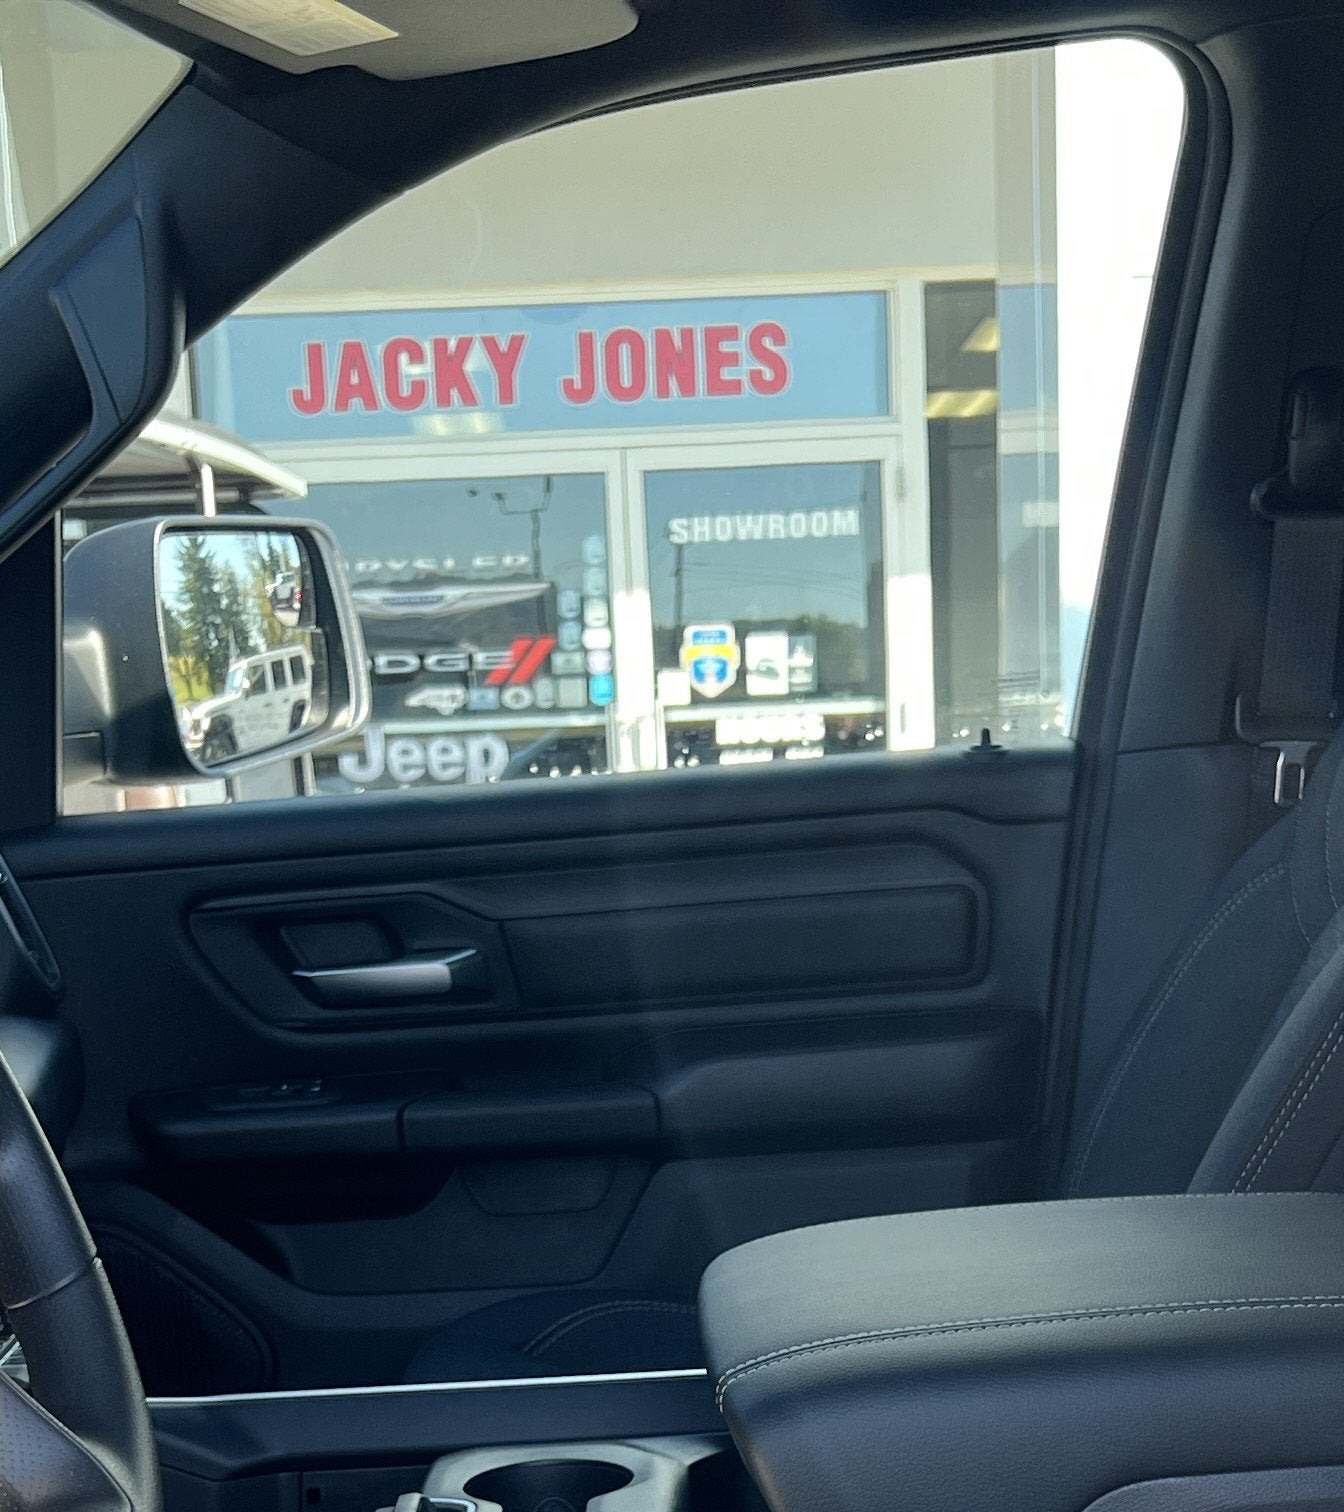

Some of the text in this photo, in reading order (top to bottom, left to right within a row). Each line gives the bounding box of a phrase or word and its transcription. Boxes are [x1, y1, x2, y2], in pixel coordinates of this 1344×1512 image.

[290, 322, 790, 415] JACKY JONES
[667, 509, 860, 544] SHOWROOM
[365, 650, 516, 675] DGE
[337, 727, 509, 784] Jeep
